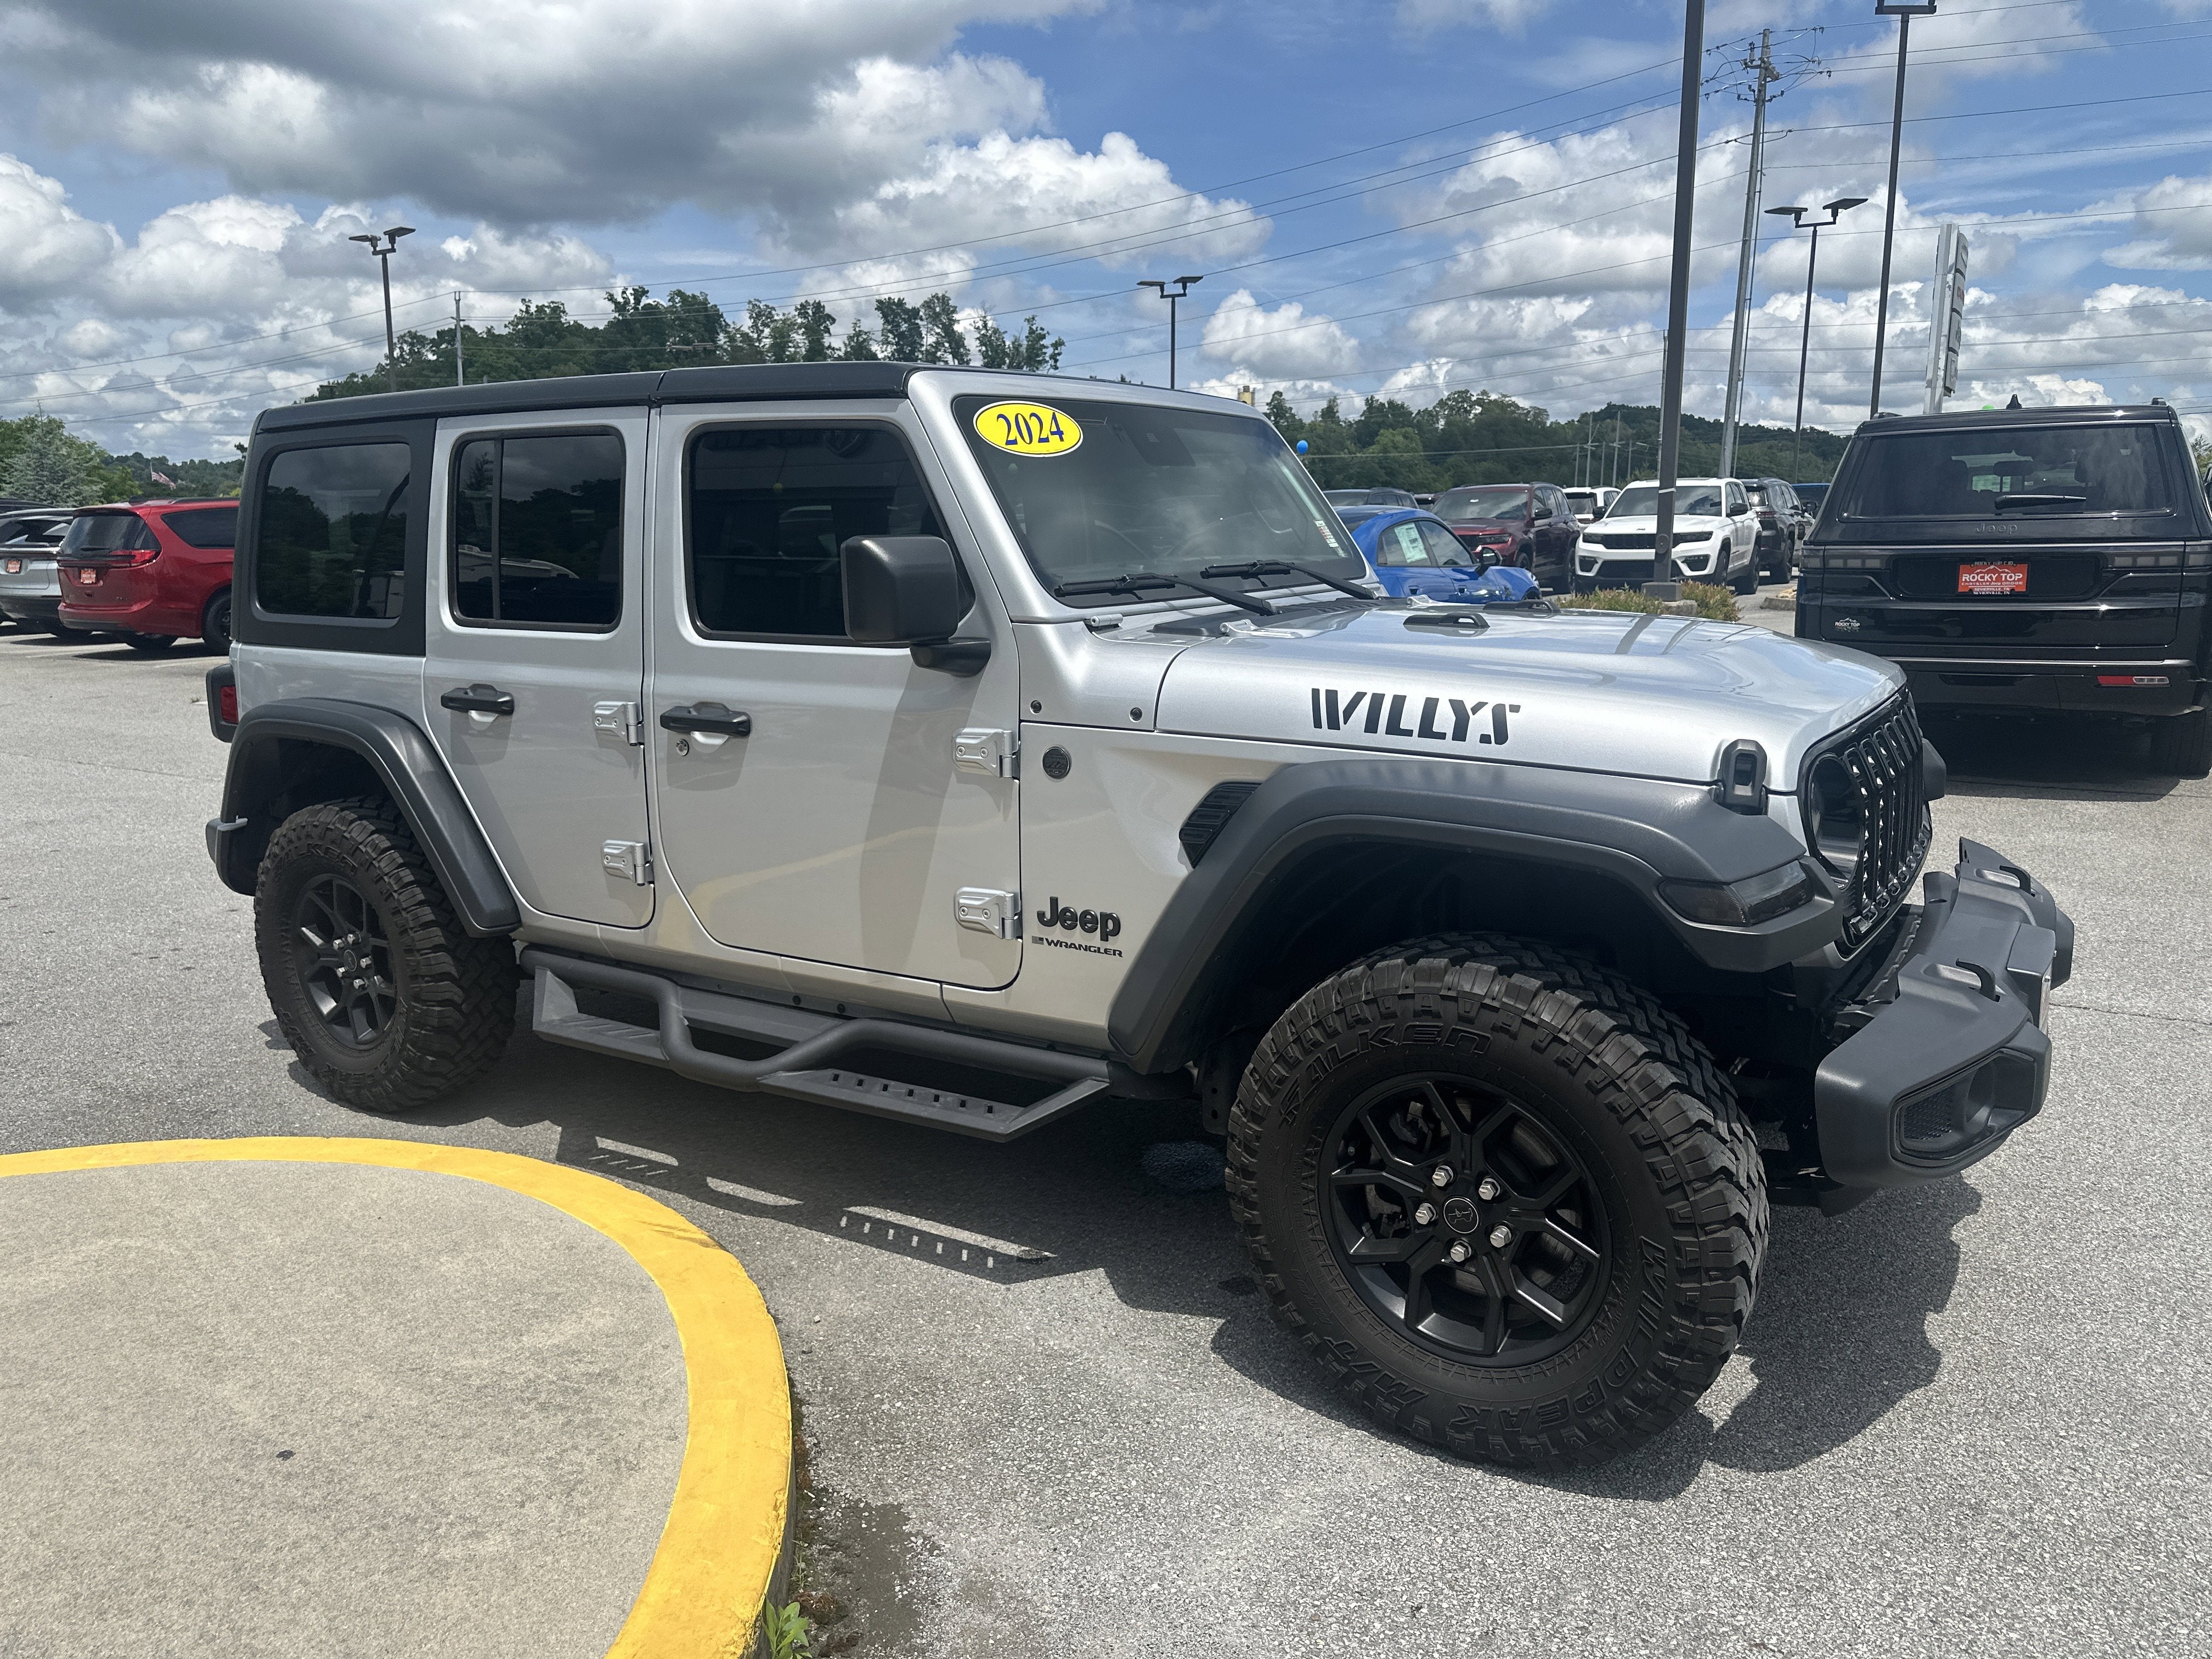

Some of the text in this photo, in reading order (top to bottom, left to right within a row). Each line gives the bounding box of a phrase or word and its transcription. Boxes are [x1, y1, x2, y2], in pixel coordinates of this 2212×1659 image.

[997, 412, 1064, 445] 2024
[1976, 523, 2017, 534] Jeep
[1962, 573, 1999, 582] ROCKY
[1312, 688, 1521, 745] WILLYS
[1037, 896, 1121, 941] Jeep
[1045, 938, 1123, 957] WRANGLER
[1279, 1022, 1493, 1127] FALKEN
[1449, 1235, 1668, 1432] WILDPEAK
[1323, 1336, 1429, 1406] M/T
